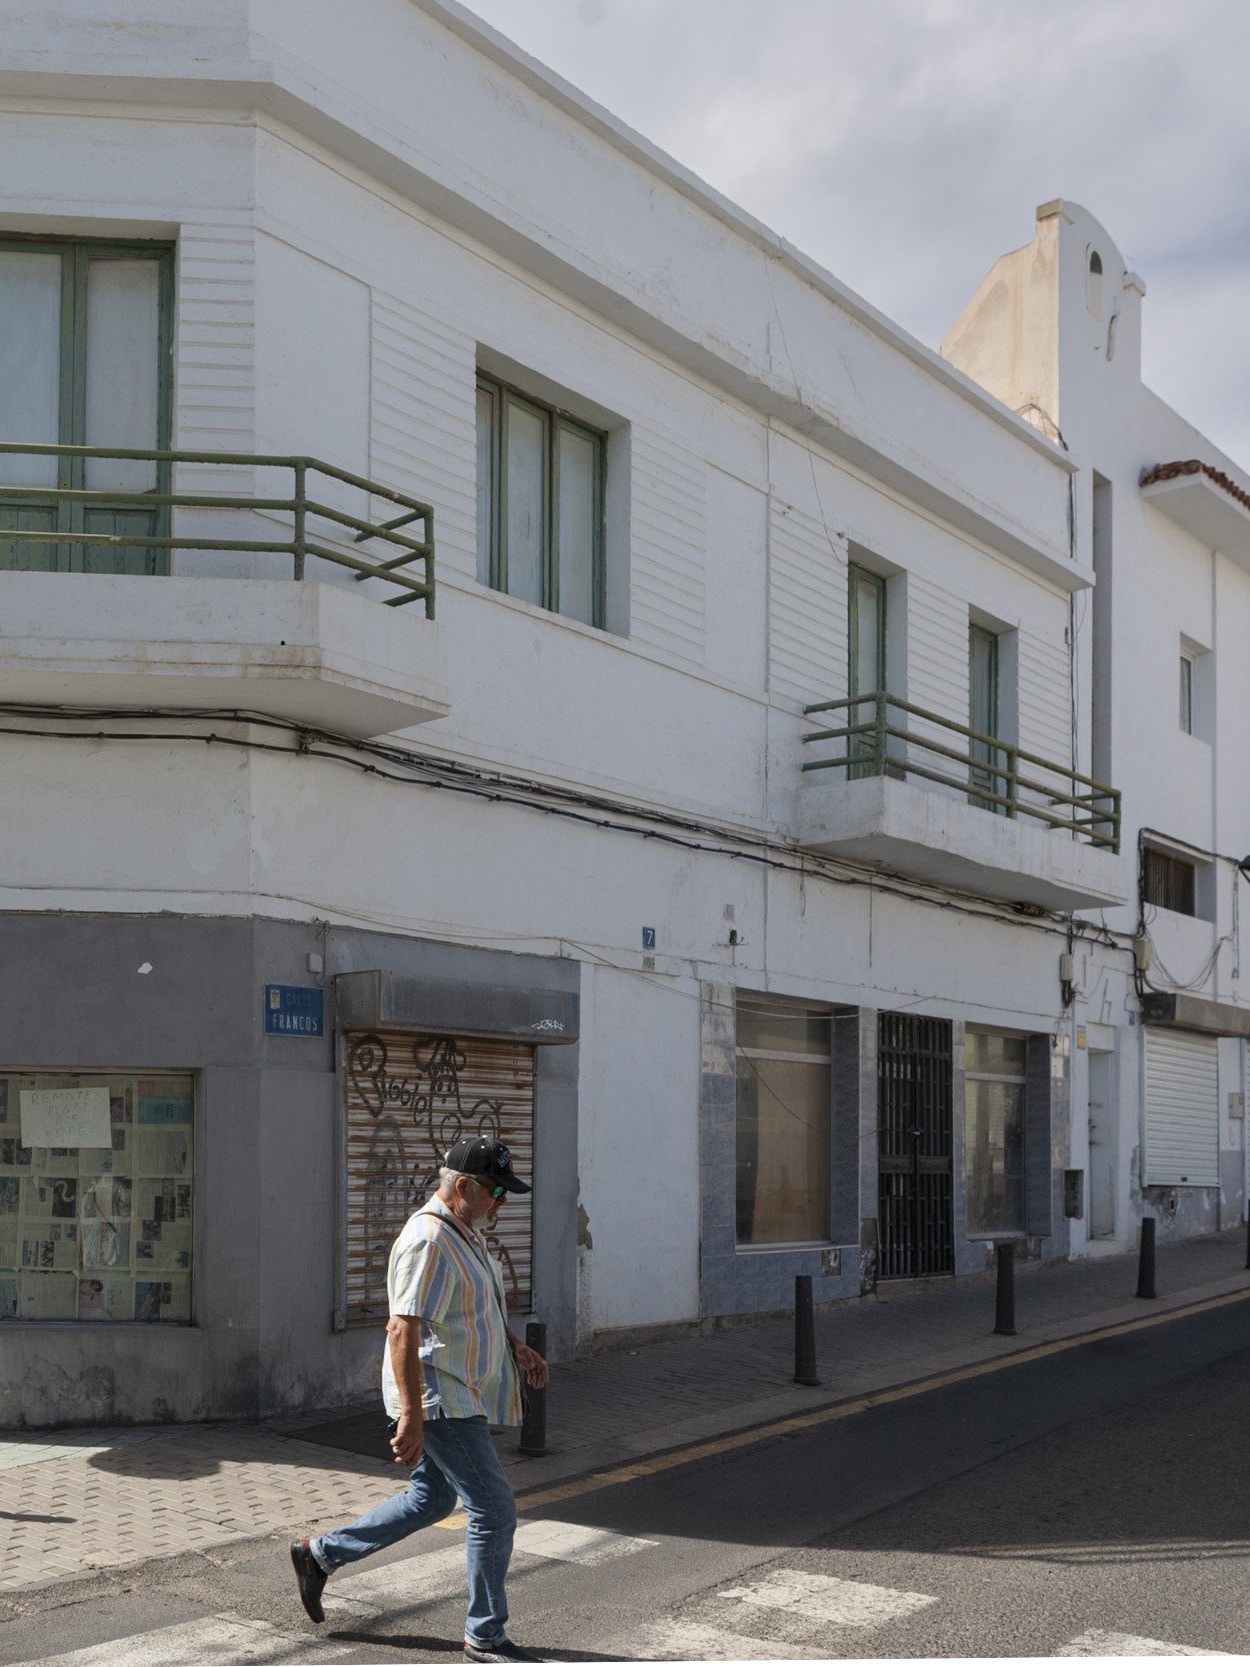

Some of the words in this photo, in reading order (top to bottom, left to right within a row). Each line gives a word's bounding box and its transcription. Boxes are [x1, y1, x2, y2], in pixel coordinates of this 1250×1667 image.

[646, 930, 653, 945] 7
[273, 1014, 317, 1032] FRANCOS
[30, 1089, 94, 1106] REMATE
